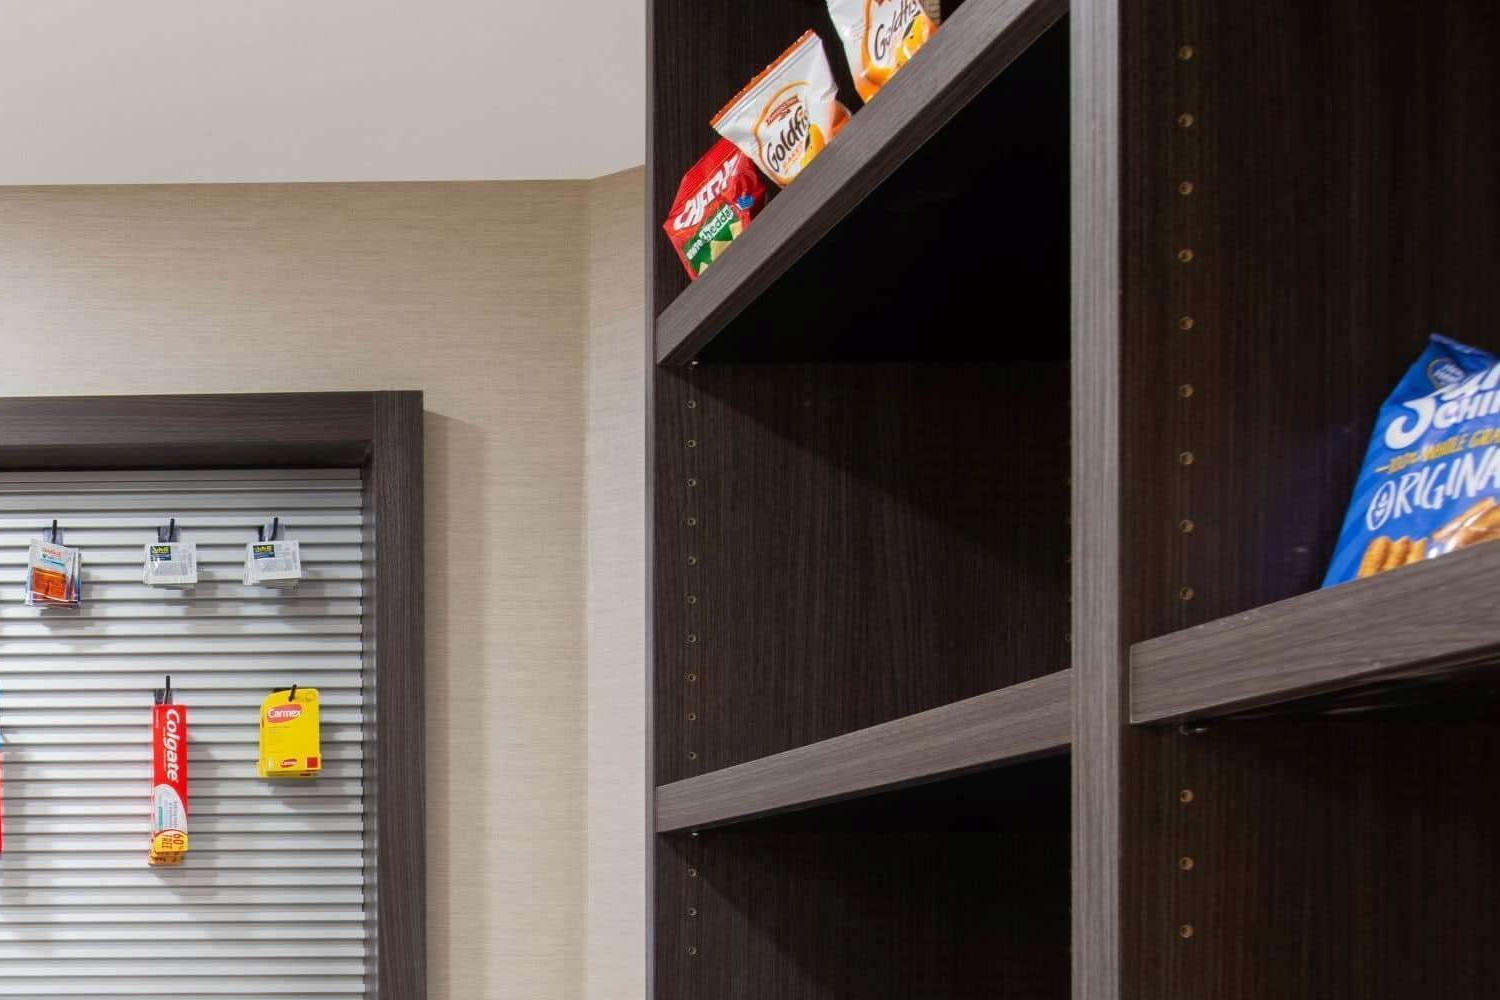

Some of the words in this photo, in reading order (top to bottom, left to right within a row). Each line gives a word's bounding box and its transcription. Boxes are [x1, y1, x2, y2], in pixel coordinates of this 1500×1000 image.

[1366, 446, 1500, 532] ORIGINA
[164, 709, 180, 782] Colgate
[267, 707, 302, 720] Carmex
